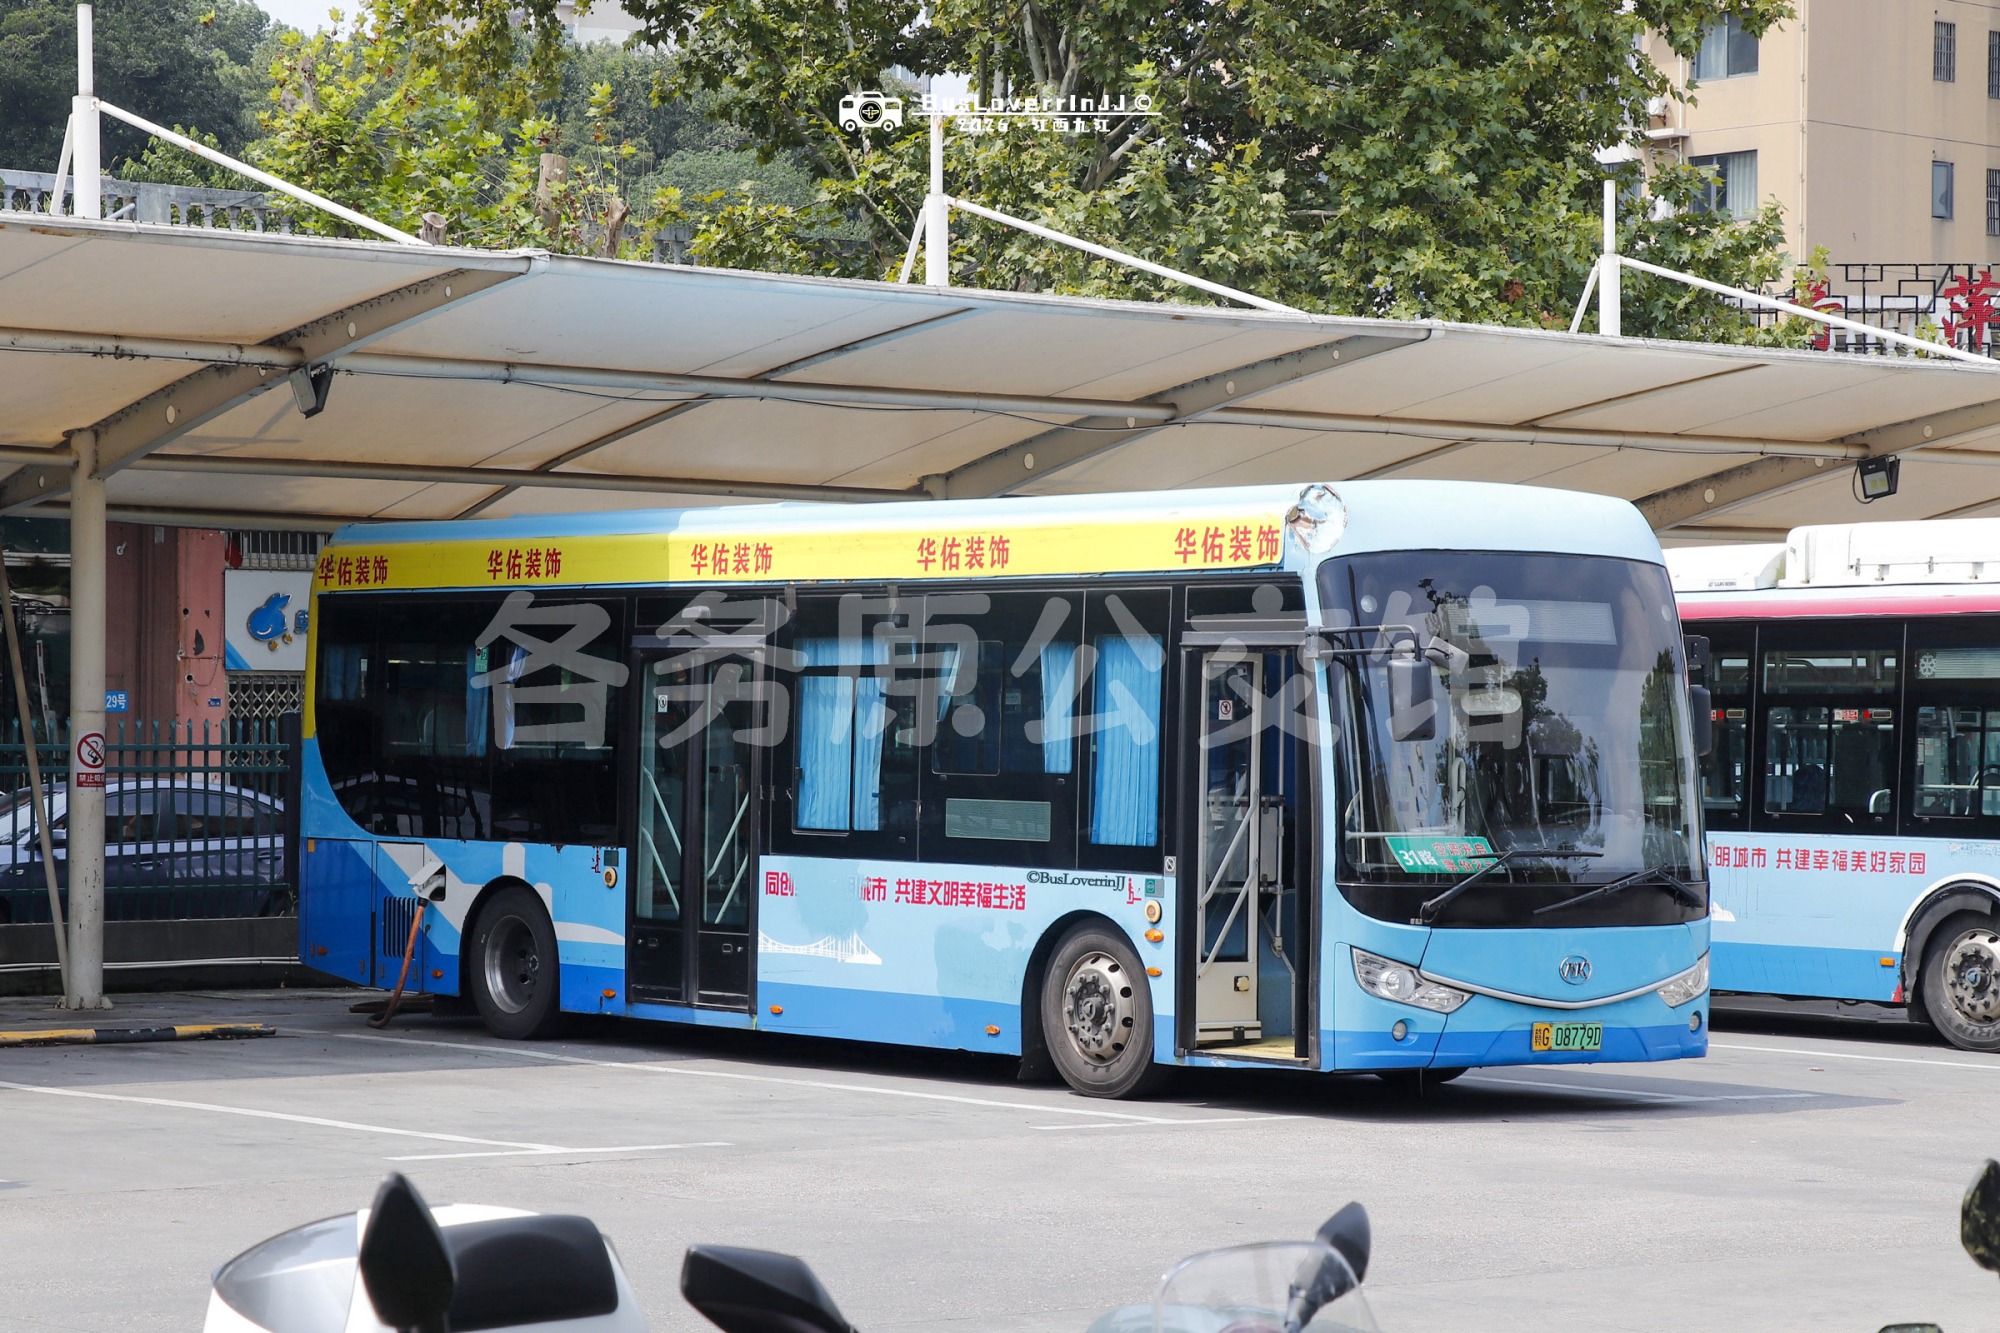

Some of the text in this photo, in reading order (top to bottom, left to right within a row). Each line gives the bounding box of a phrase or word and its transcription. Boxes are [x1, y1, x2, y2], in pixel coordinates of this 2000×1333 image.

[319, 525, 1280, 586] 华佑装饰 华佑装饰 华佑装饰 华佑装饰 华佑装饰
[1399, 850, 1438, 866] 31路
[1708, 846, 1766, 869] 明城市
[1776, 847, 1926, 875] 共建幸福美好家园
[895, 878, 1026, 910] 共建文明幸福生活
